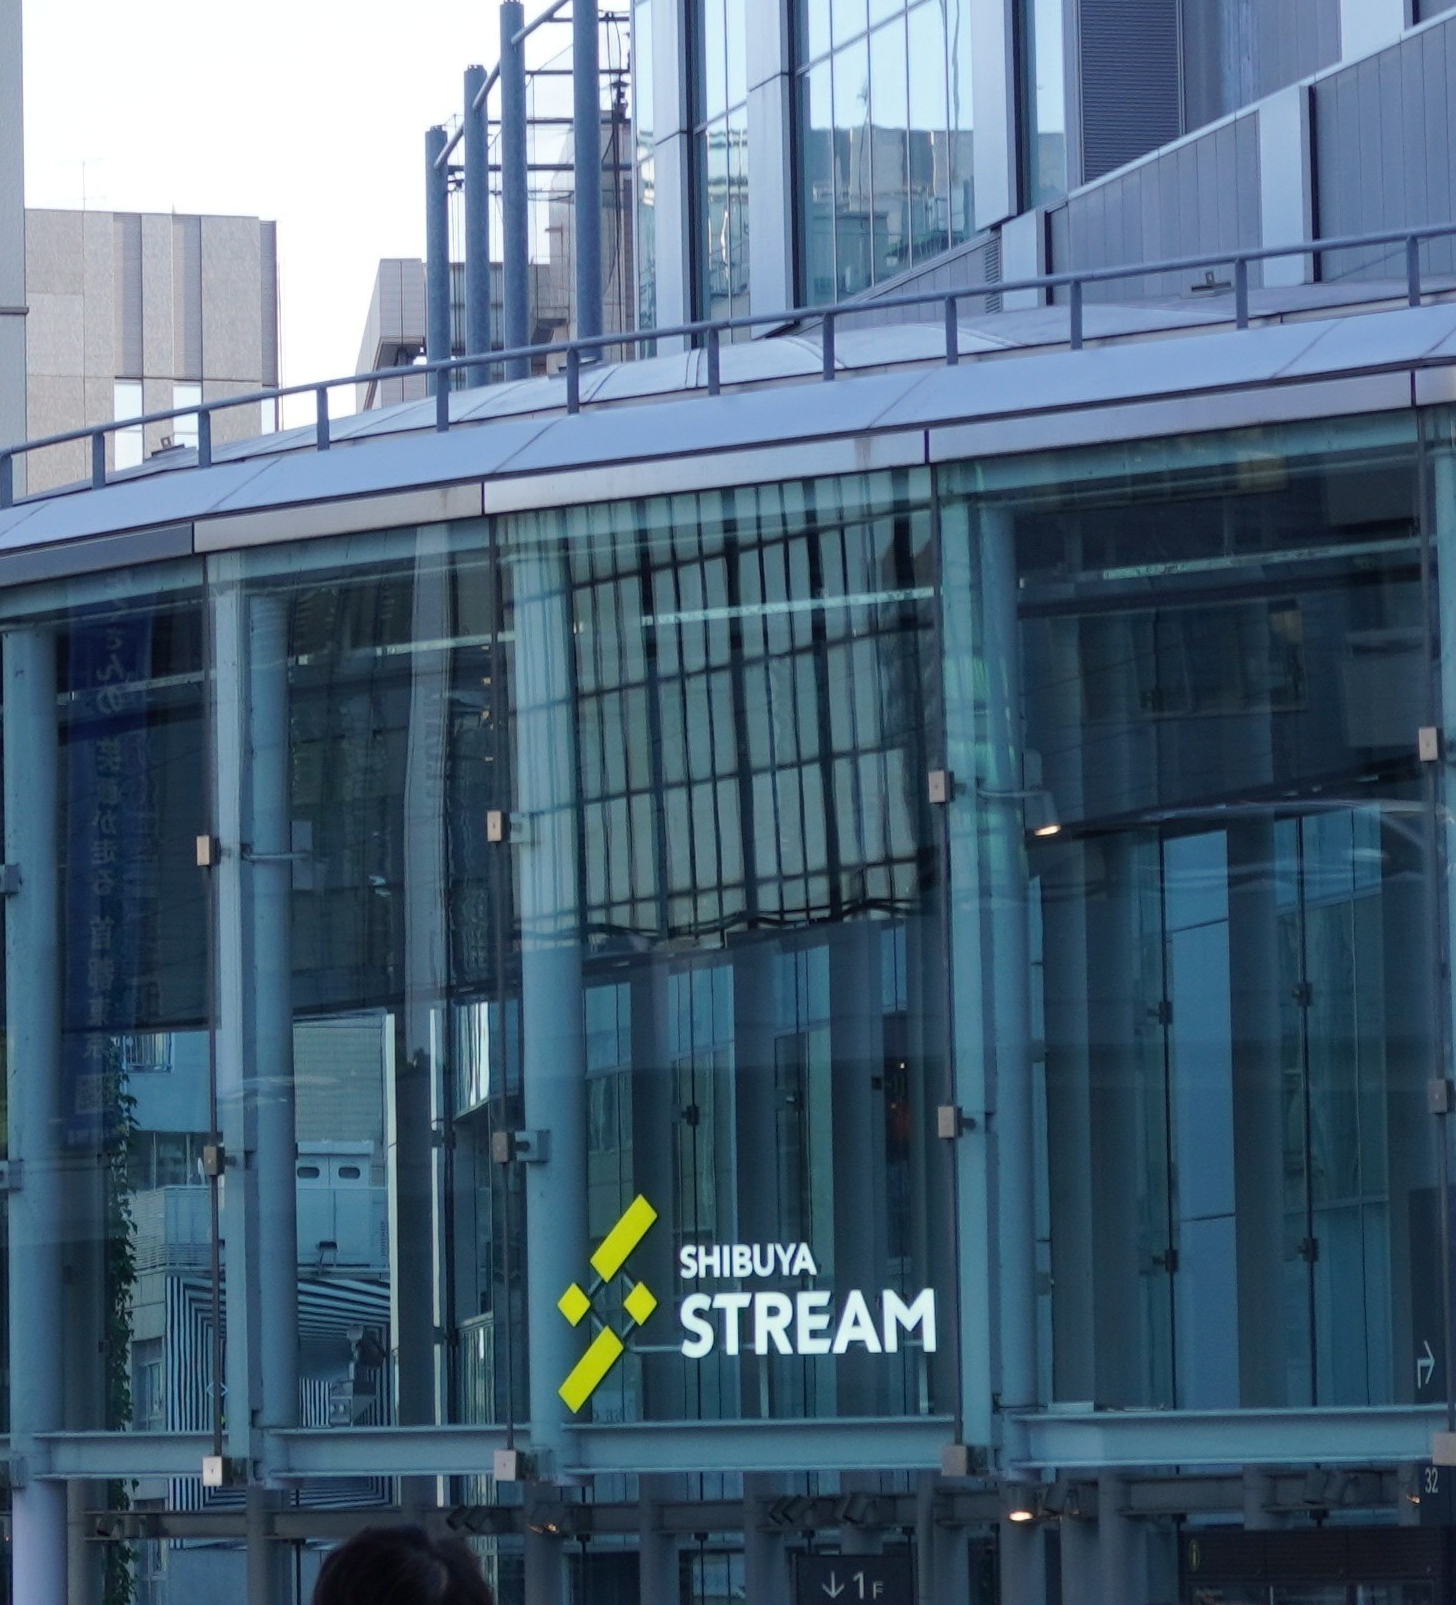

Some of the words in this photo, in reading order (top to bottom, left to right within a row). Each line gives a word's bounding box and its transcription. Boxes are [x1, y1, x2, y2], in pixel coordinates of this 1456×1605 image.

[679, 1242, 818, 1279] SHIBUYA
[679, 1287, 937, 1359] STREAM
[1424, 1466, 1439, 1494] 32
[853, 1571, 884, 1600] 1F
